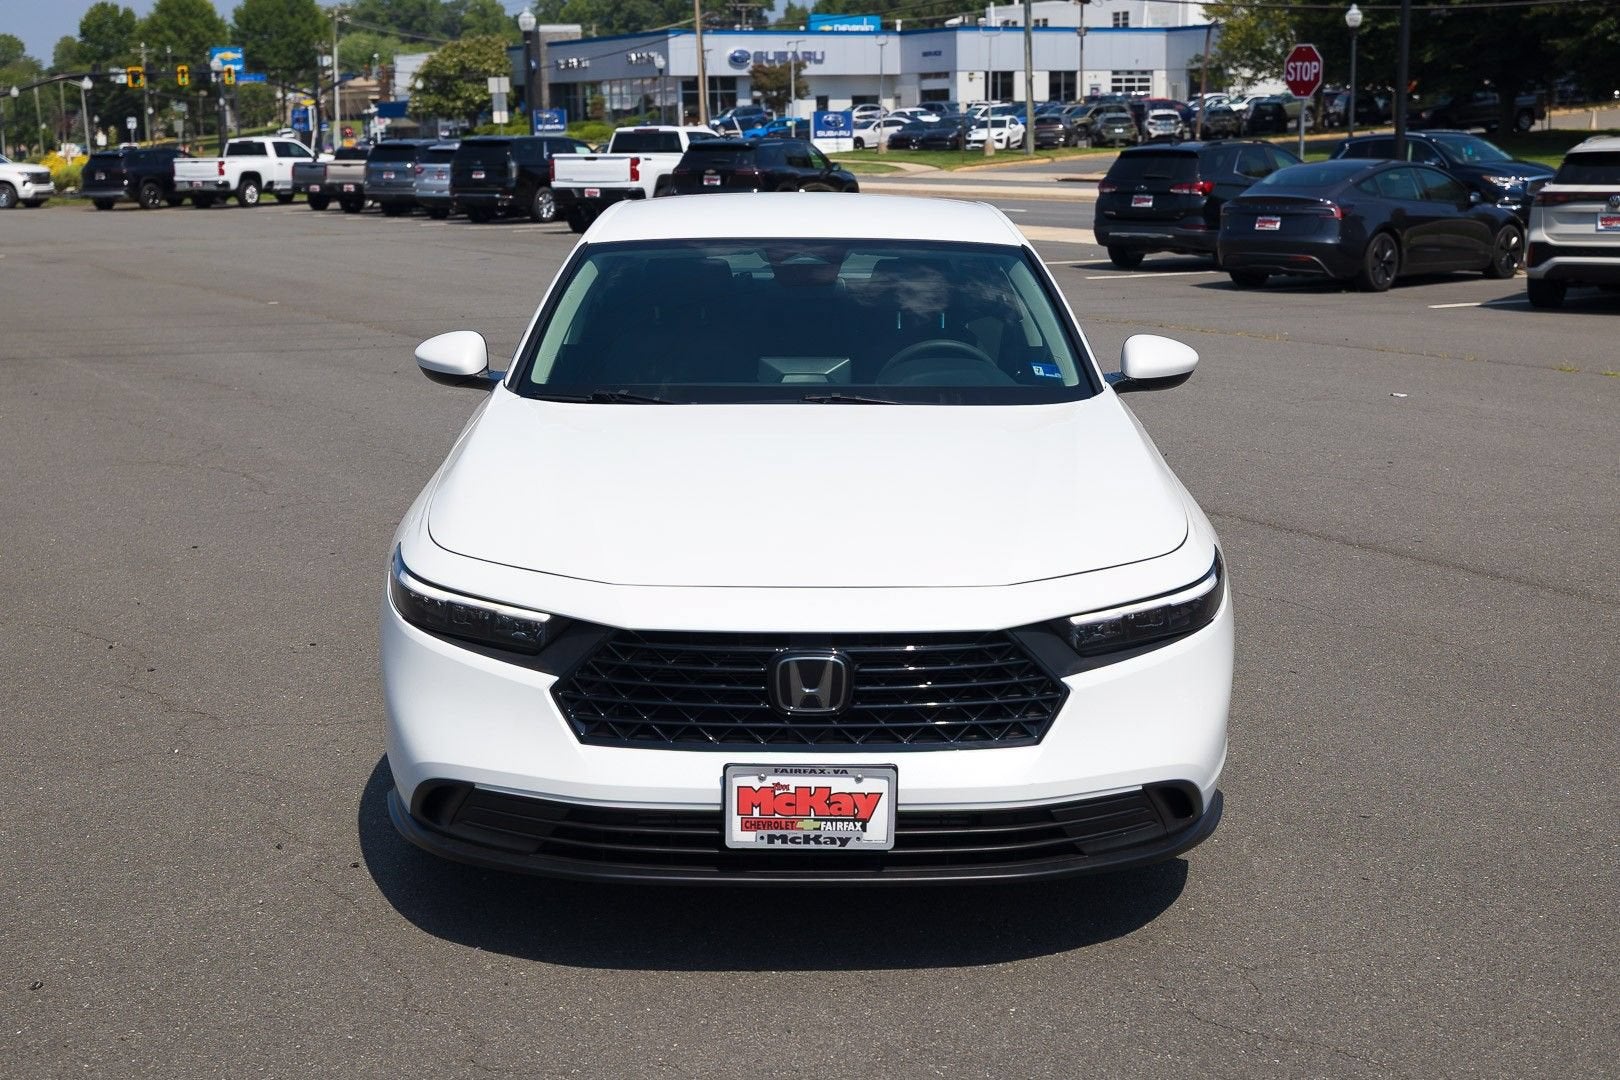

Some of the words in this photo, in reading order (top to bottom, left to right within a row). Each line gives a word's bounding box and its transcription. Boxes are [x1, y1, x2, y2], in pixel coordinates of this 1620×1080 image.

[753, 50, 825, 65] SUBARU
[1287, 61, 1320, 81] STOP
[737, 786, 883, 823] McKay
[744, 820, 795, 831] CHEVROLET
[821, 821, 863, 832] FAIRFAX
[766, 833, 851, 847] McKay
